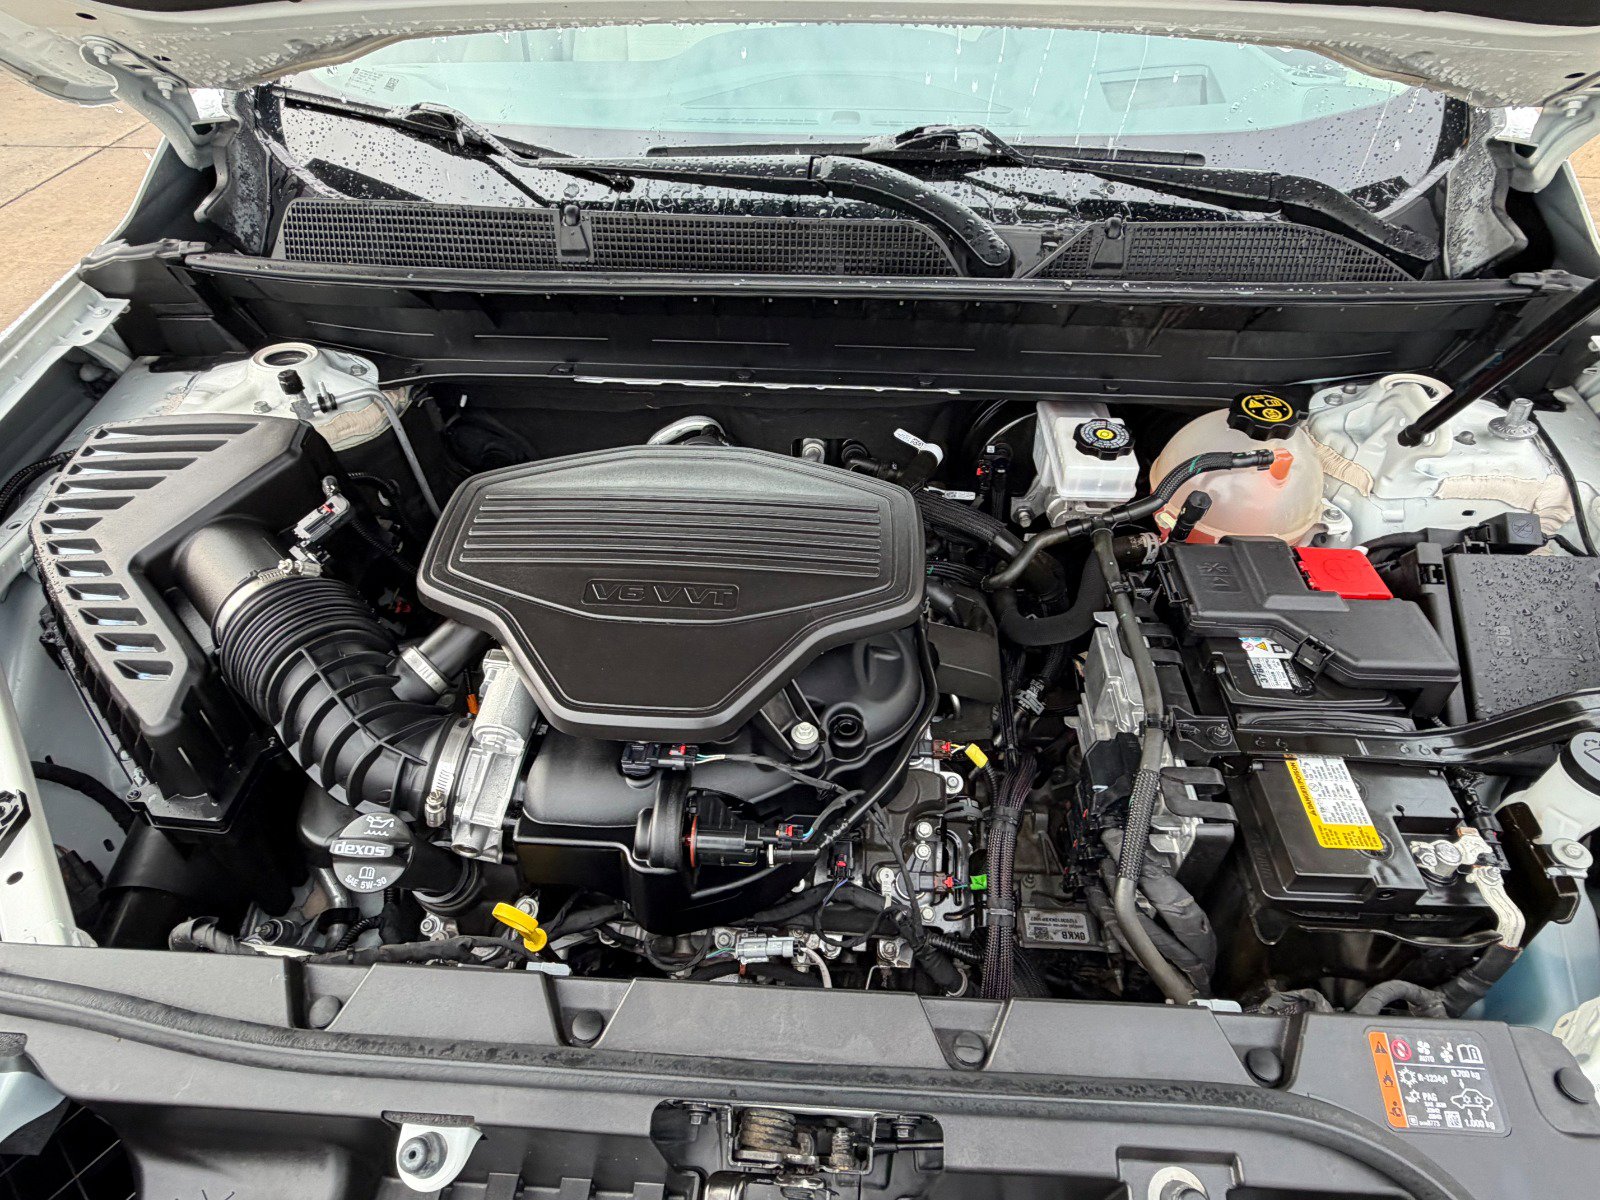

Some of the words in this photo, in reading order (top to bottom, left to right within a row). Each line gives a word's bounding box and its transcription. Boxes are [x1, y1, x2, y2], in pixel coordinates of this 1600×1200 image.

[591, 583, 645, 601] V6
[653, 585, 733, 606] VVT
[335, 841, 388, 856] dexos
[345, 874, 359, 887] SAE
[360, 876, 387, 889] 5W-30
[1422, 1092, 1438, 1102] PAG
